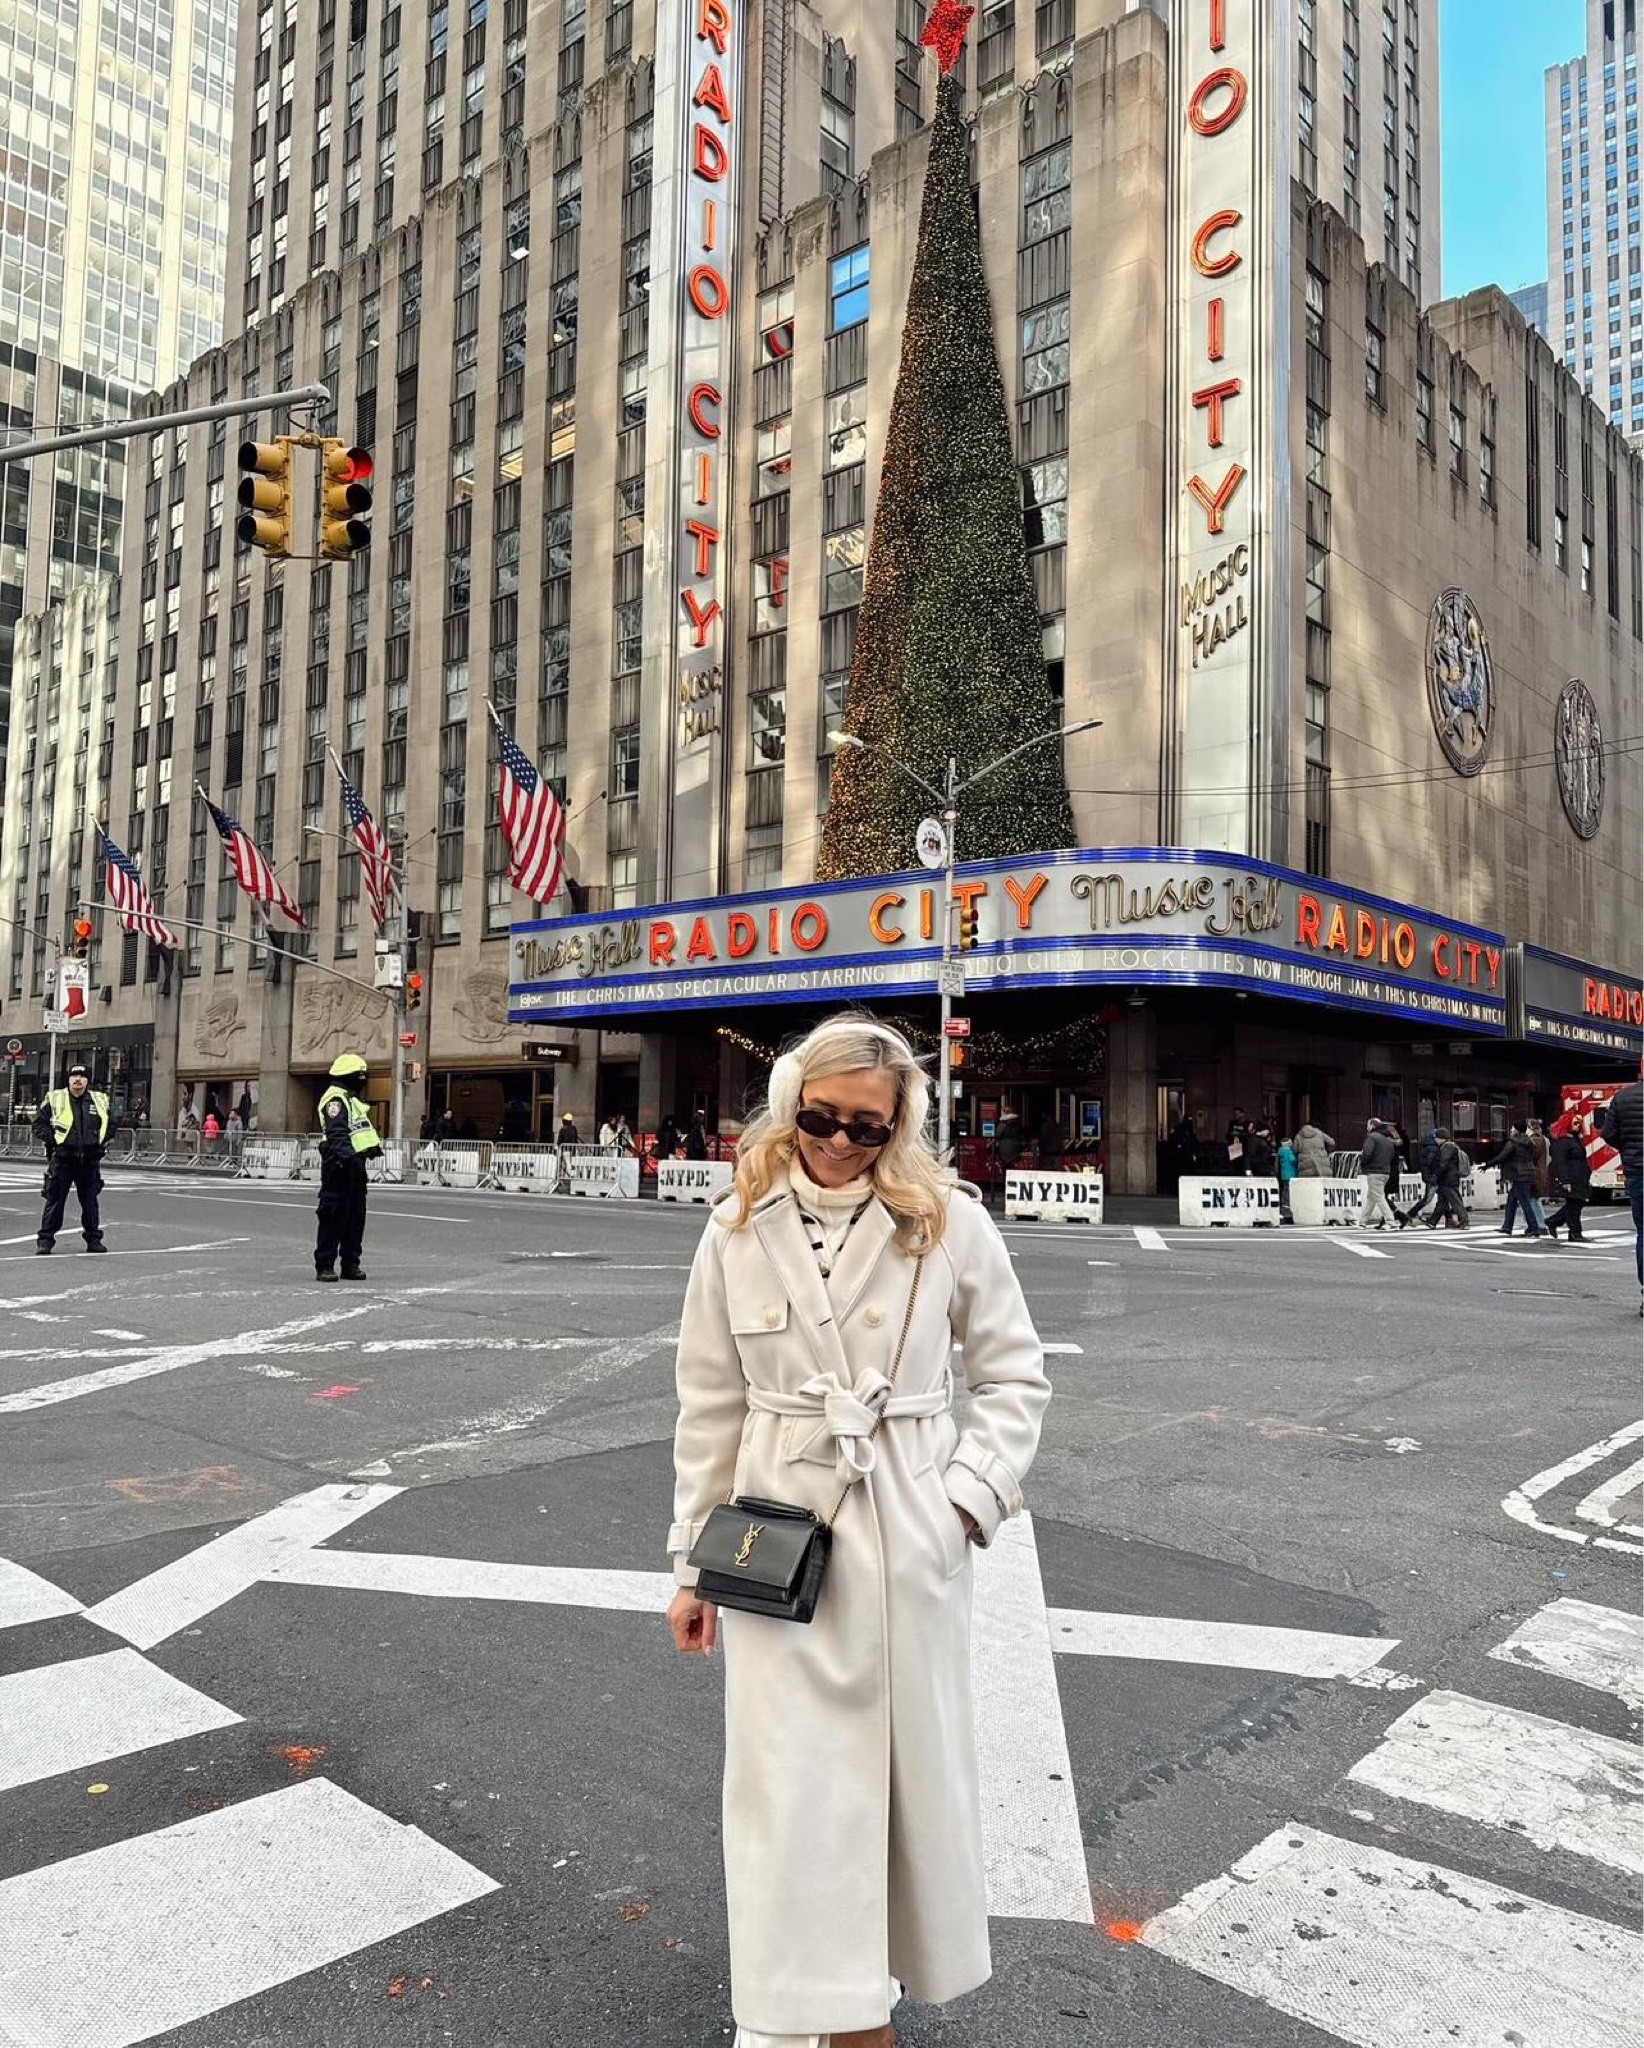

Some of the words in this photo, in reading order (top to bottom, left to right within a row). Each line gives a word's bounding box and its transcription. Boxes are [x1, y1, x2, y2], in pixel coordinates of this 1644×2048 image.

[689, 0, 732, 320] RADIO
[1187, 209, 1248, 535] CITY
[681, 382, 723, 648] CITY
[1180, 543, 1249, 628] MUSIC
[1191, 595, 1249, 669] HALL
[516, 935, 583, 980] Music
[576, 918, 643, 978] Hall
[649, 902, 829, 966] RADIO
[869, 872, 1047, 944] CITY
[1070, 873, 1215, 930] Music
[1205, 877, 1284, 936] Hall
[1296, 893, 1417, 968] RADIO
[1433, 932, 1501, 989] CITY
[555, 991, 577, 1006] THE
[586, 983, 664, 1004] CHRISTMAS
[675, 973, 788, 998] SPECTACULAR
[799, 967, 885, 989] STARRING
[1104, 949, 1244, 974] ROCKETTES
[1253, 958, 1282, 980] NOW
[1290, 965, 1342, 992] THROUGH
[1349, 979, 1368, 998] JAN
[1374, 984, 1380, 999] 4
[1385, 986, 1405, 1005] THIS
[1409, 991, 1418, 1008] IS
[1421, 993, 1469, 1017] CHRISTMAS
[1472, 1002, 1480, 1019] IN
[1583, 976, 1643, 1025] RADIO
[666, 1169, 706, 1187] NYPD
[1019, 1182, 1088, 1204] NYPD
[1212, 1188, 1270, 1209] NYPD
[1328, 1188, 1358, 1208] NYPD
[1402, 1184, 1418, 1202] YPD
[735, 1523, 768, 1569] YSL
